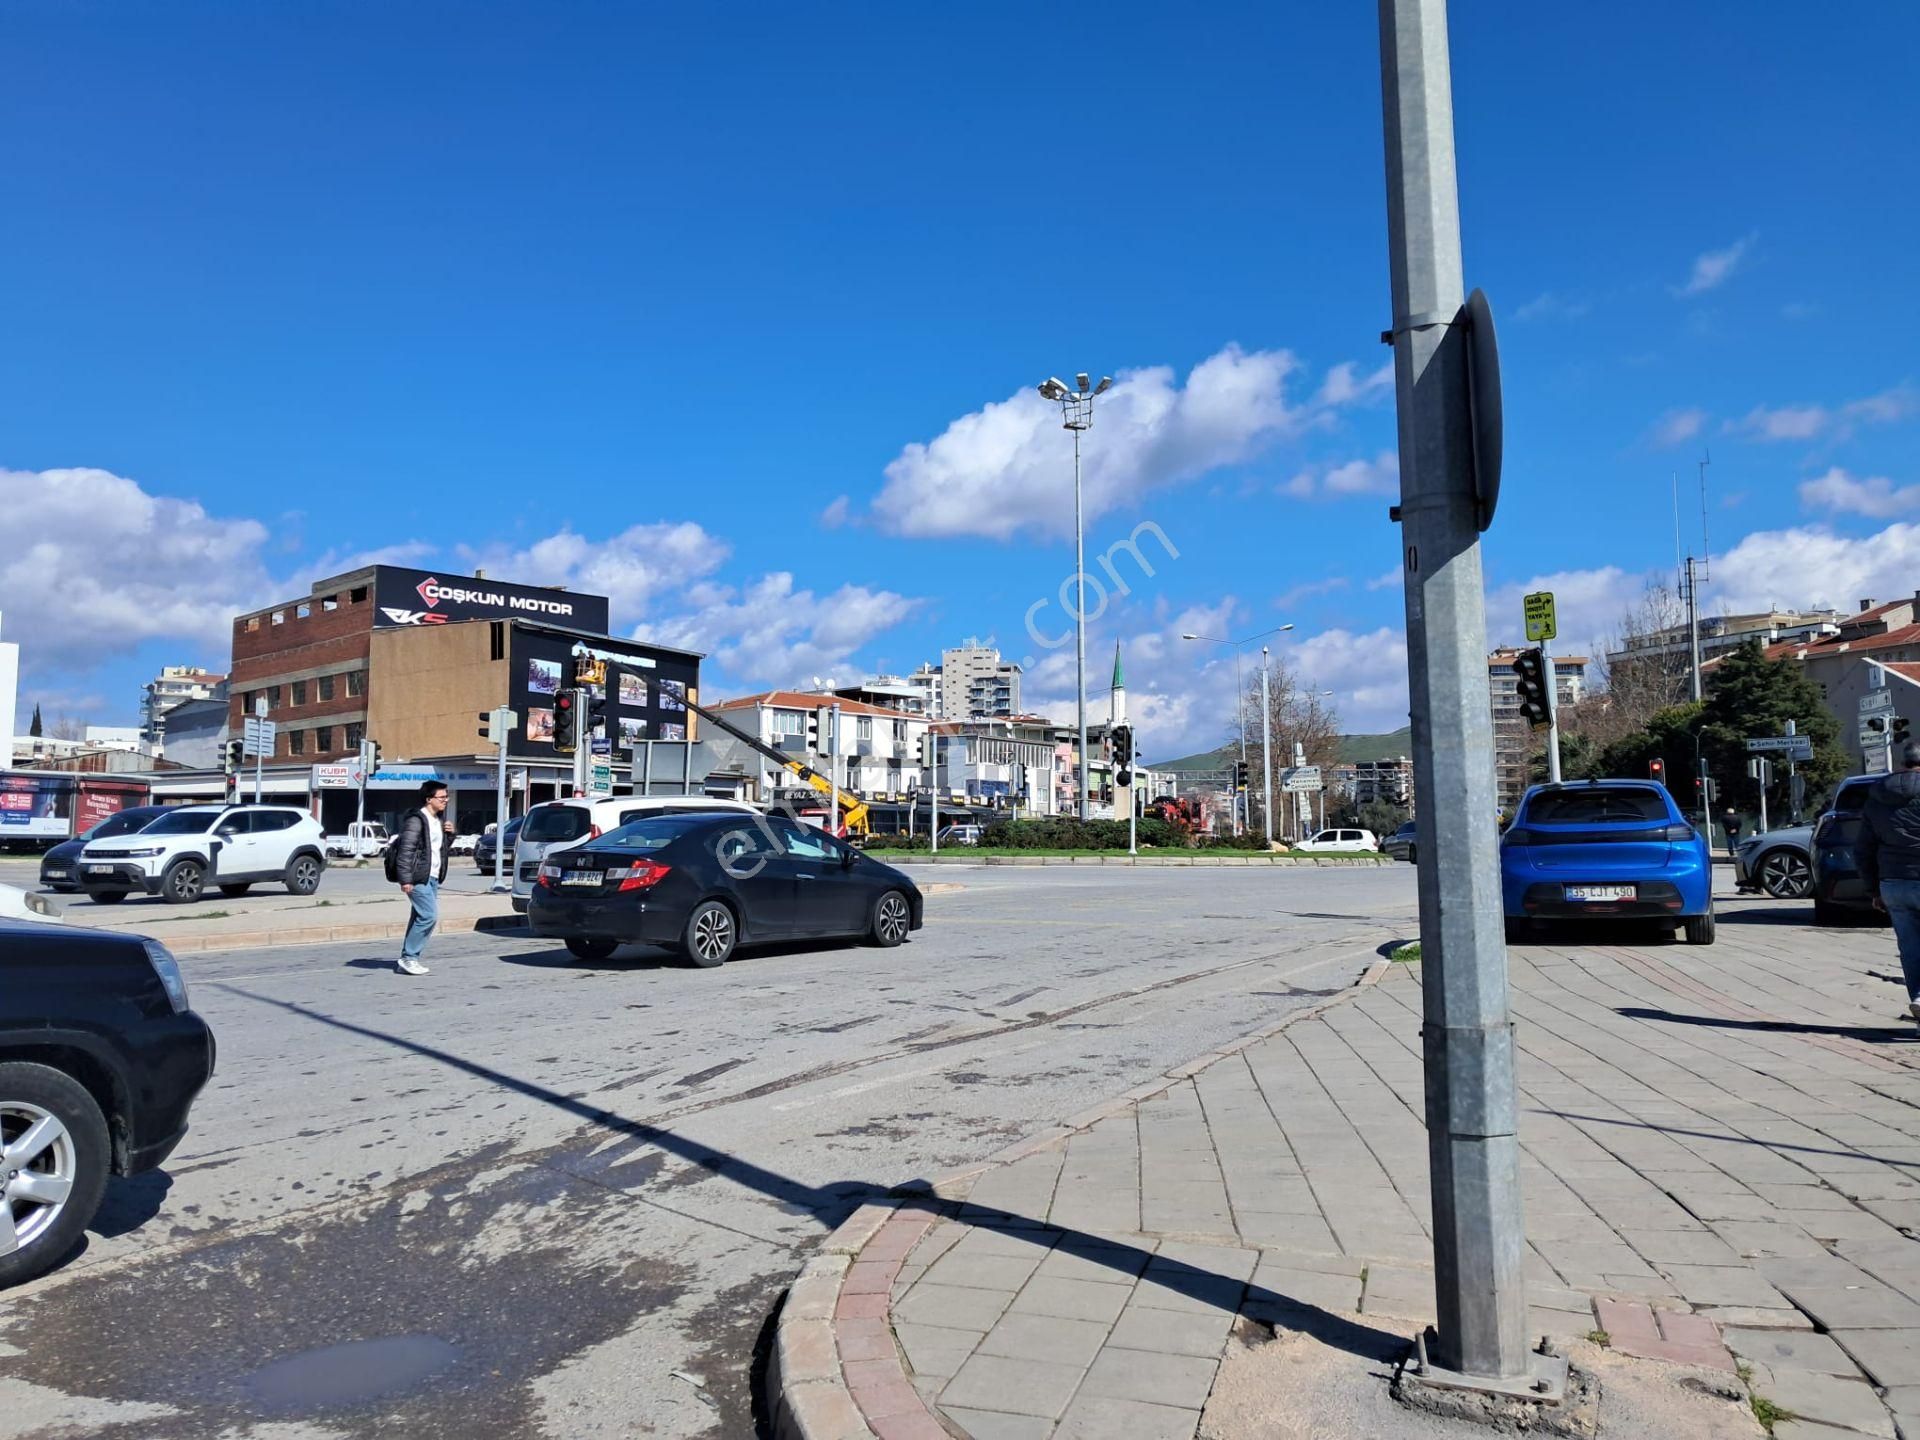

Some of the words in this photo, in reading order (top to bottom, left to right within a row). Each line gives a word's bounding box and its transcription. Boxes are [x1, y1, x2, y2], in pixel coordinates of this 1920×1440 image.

[425, 585, 505, 607] COŞKUN
[509, 596, 573, 616] MOTOR
[320, 767, 348, 775] KUBA
[784, 791, 806, 799] BEYAZ
[1573, 888, 1585, 897] 35
[1613, 887, 1633, 897] 490
